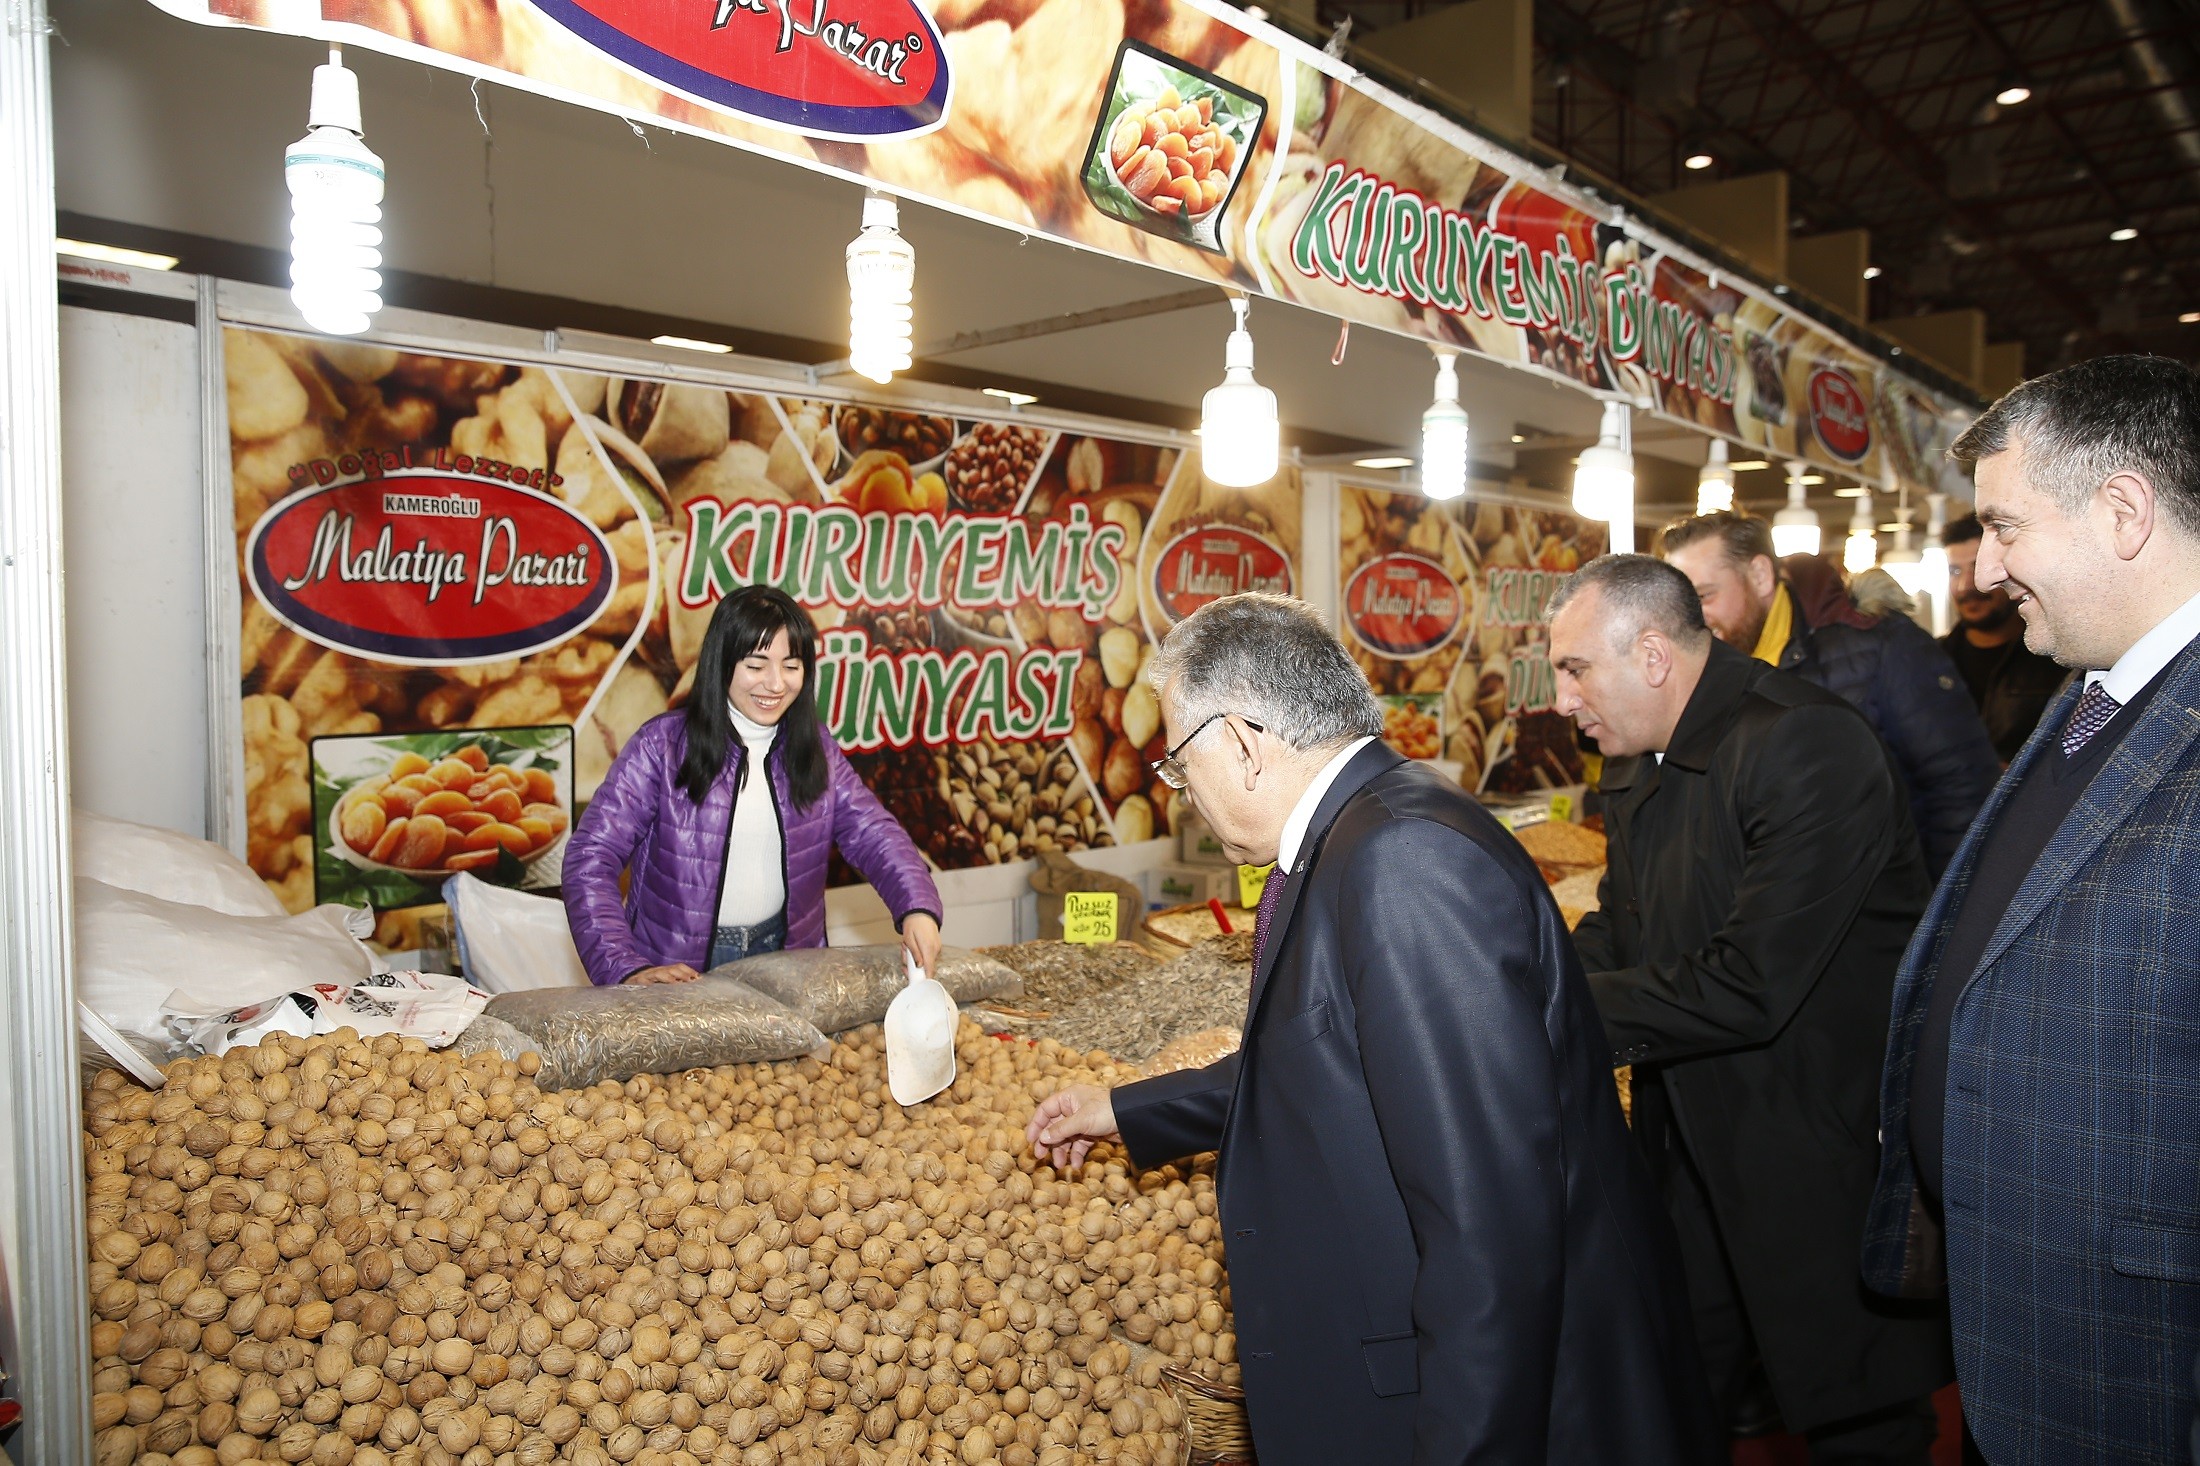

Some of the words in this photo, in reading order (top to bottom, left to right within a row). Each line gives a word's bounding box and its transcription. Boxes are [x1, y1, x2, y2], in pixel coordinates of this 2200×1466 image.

[1291, 159, 1597, 363] KURUYEMİŞ
[283, 509, 467, 604] Malatya
[384, 494, 480, 516] KAMEROĞLU
[682, 498, 1126, 621] KURUYEMİŞ
[816, 630, 1083, 749] ÜNYASI
[1093, 920, 1112, 937] 25
